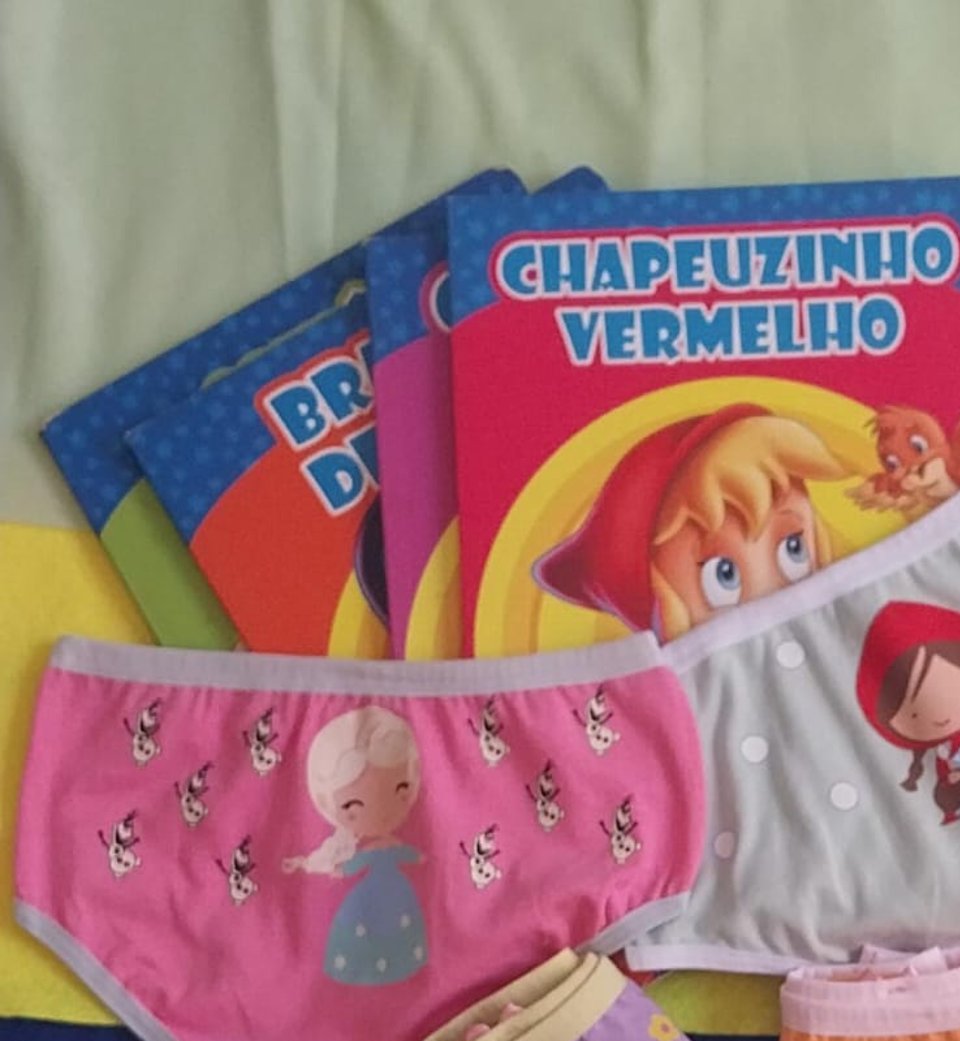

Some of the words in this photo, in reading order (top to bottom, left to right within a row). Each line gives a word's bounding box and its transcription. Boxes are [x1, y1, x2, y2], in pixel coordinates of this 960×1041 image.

[496, 224, 956, 298] CHAPEUZINHO
[558, 297, 904, 363] VERMELHO
[265, 342, 373, 448] BR
